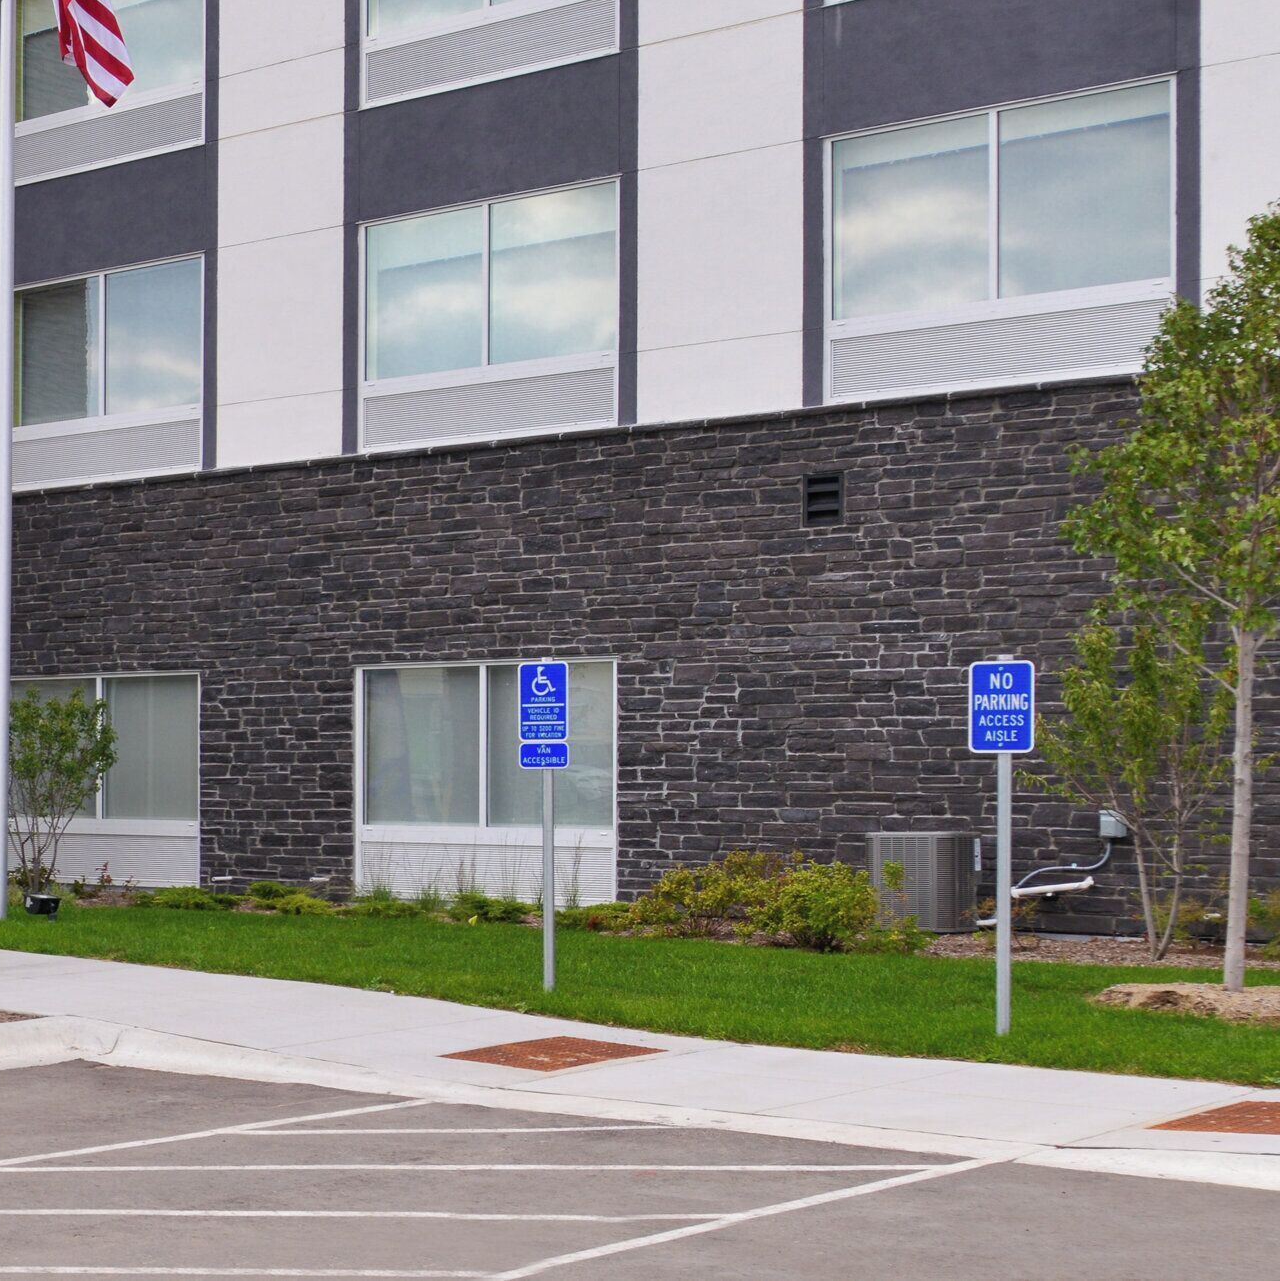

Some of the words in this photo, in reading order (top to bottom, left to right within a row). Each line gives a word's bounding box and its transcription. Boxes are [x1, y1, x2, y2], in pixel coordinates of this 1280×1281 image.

[989, 672, 1013, 690] NO
[974, 693, 1029, 711] PARKING
[978, 714, 1025, 726] ACCESS
[984, 730, 1018, 742] AISLE
[523, 756, 565, 764] ACCESSIBLE
